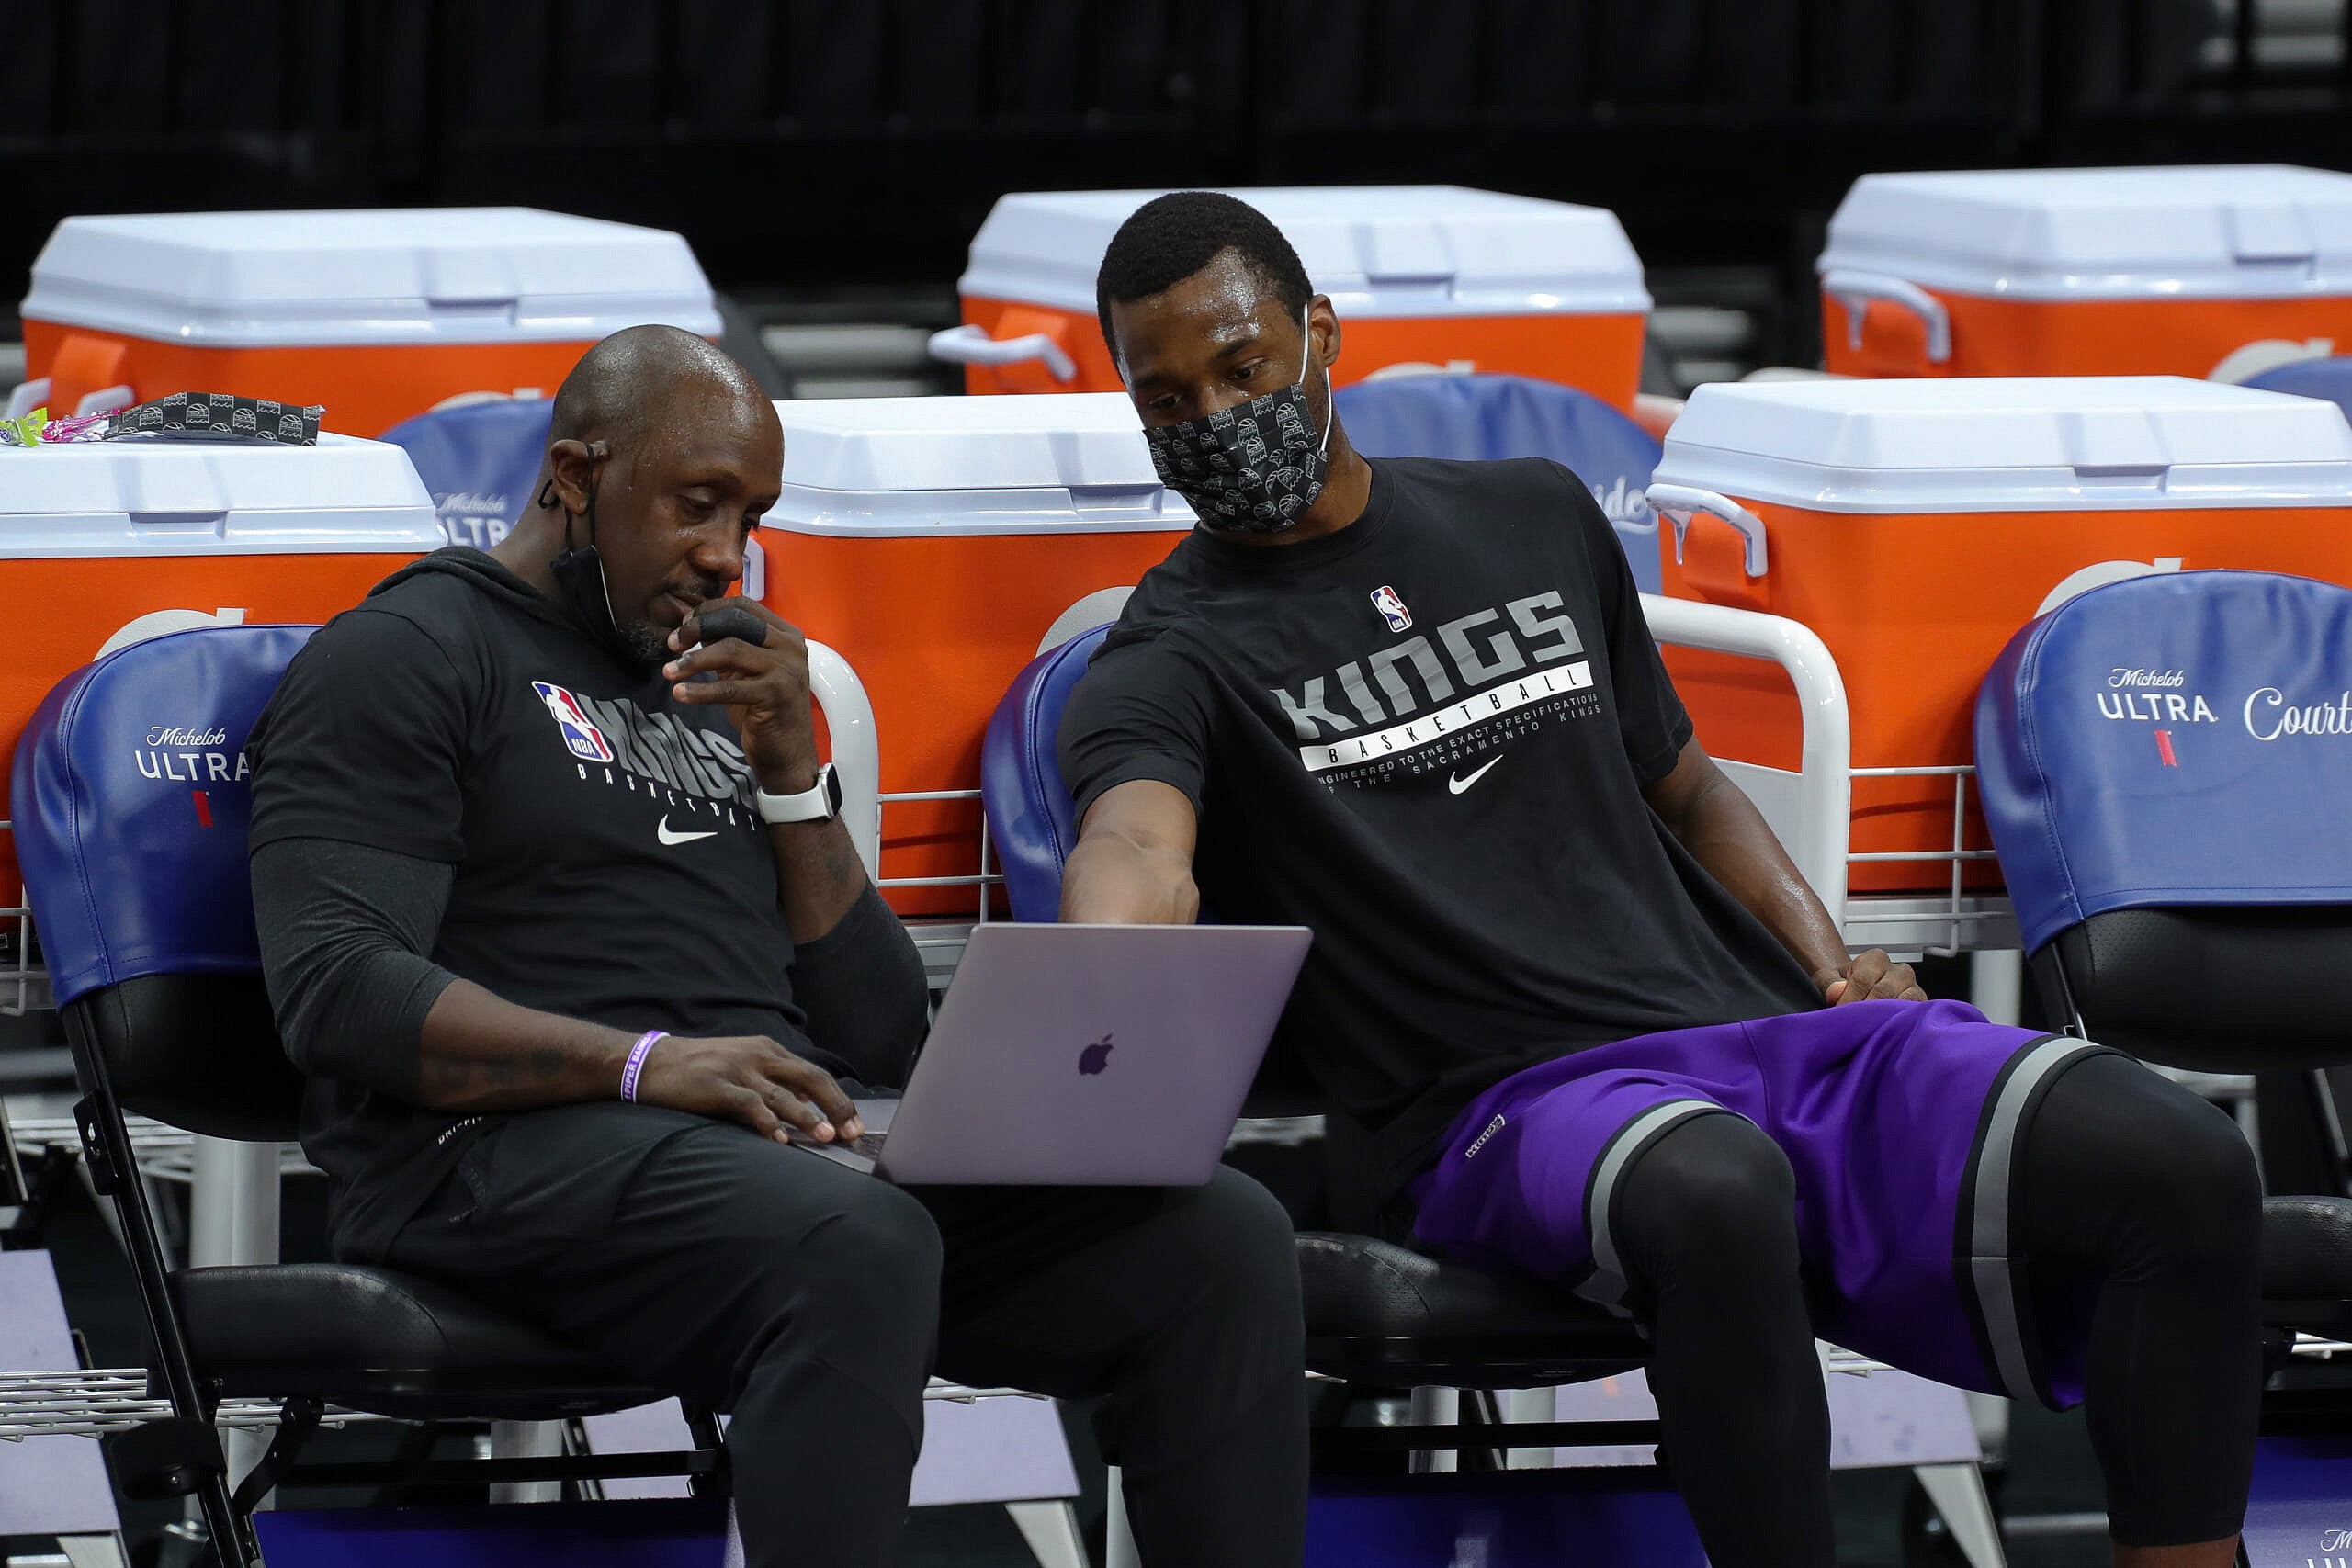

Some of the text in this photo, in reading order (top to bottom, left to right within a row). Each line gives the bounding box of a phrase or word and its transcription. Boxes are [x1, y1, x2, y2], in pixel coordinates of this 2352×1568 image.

[446, 517, 527, 548] LTR
[1269, 589, 1585, 740] KINGS
[2108, 668, 2185, 688] Michelob
[1328, 668, 1577, 764] BASKETBALL
[2096, 693, 2217, 723] ULTRA
[2244, 687, 2352, 741] Court
[146, 725, 227, 747] Michelob
[571, 738, 594, 756] NBA
[1317, 693, 1598, 785] NGINEERED TO THE EXACT SPECIFICATIONS
[1354, 773, 1391, 790] THE
[1412, 721, 1540, 775] SACRAMENTO
[1559, 705, 1601, 723] KINGS
[134, 750, 250, 782] ULTRA
[577, 763, 755, 831] BASKETBAL
